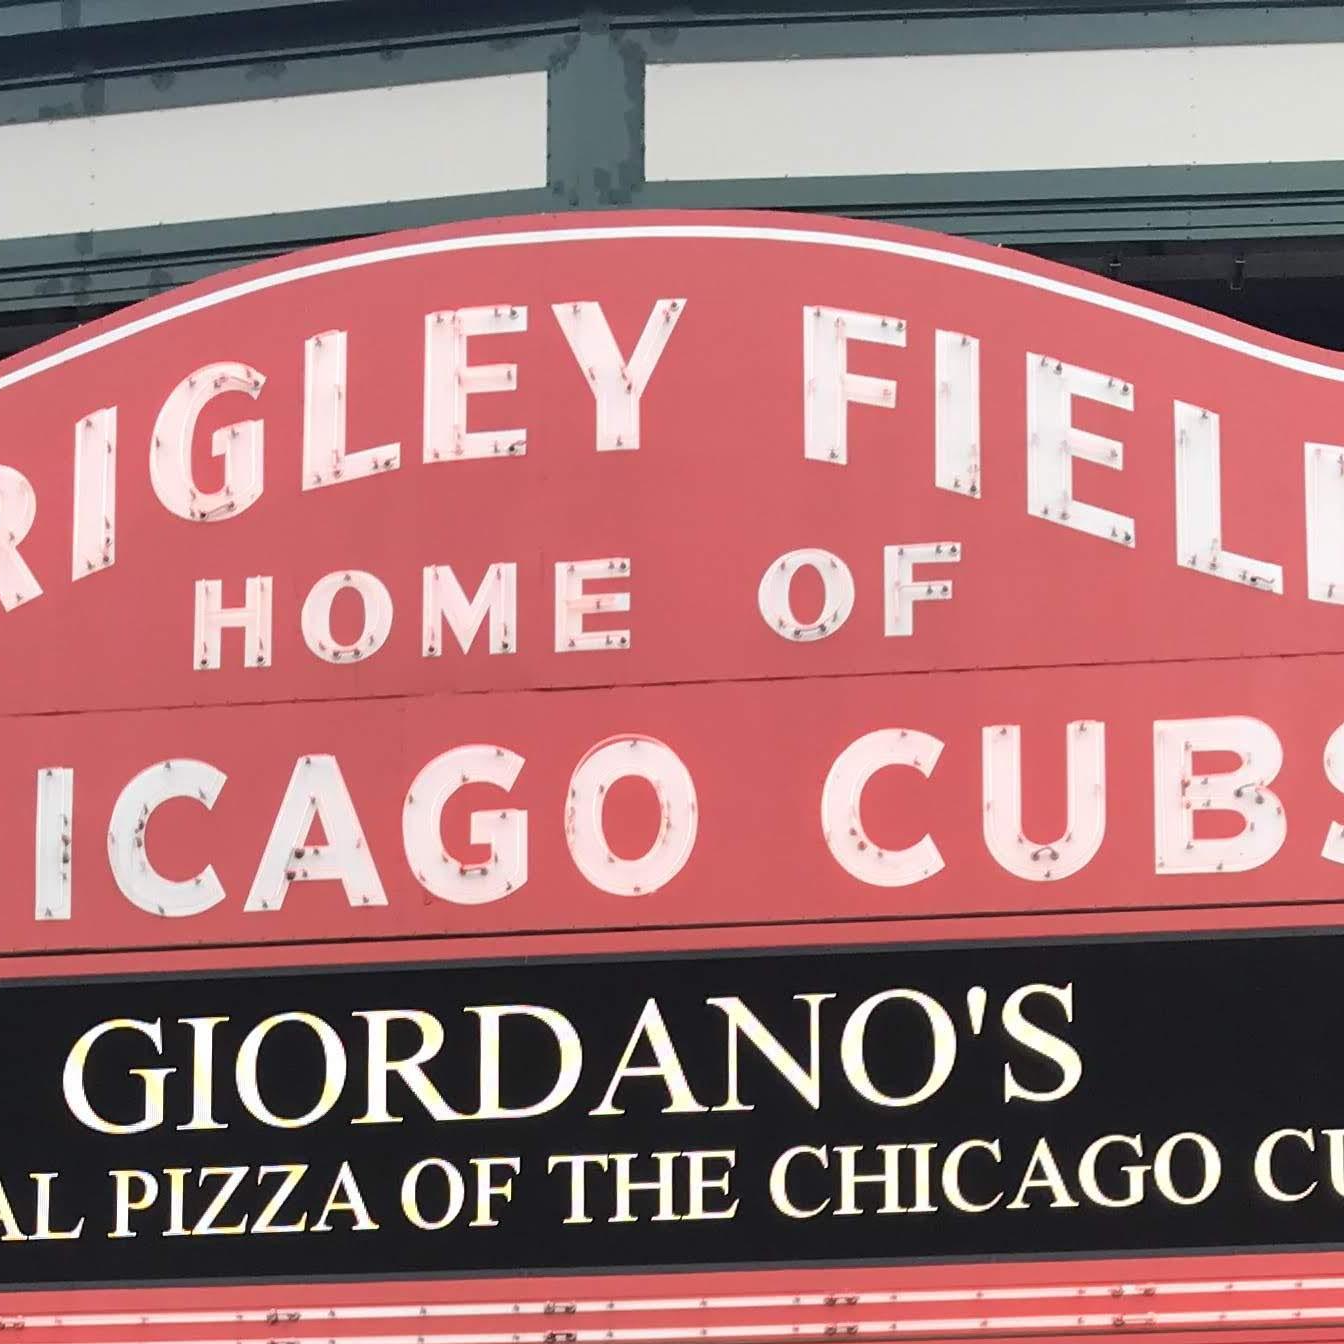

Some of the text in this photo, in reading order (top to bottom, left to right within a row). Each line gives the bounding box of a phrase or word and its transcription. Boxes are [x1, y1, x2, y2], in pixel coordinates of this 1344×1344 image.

[194, 542, 961, 669] HOME OF
[62, 982, 1086, 1135] GIORDANO'S
[108, 1162, 379, 1237] PIZZA
[402, 1158, 520, 1229] OF
[548, 1151, 739, 1223] THE
[770, 1133, 1220, 1218] CHICAGO
